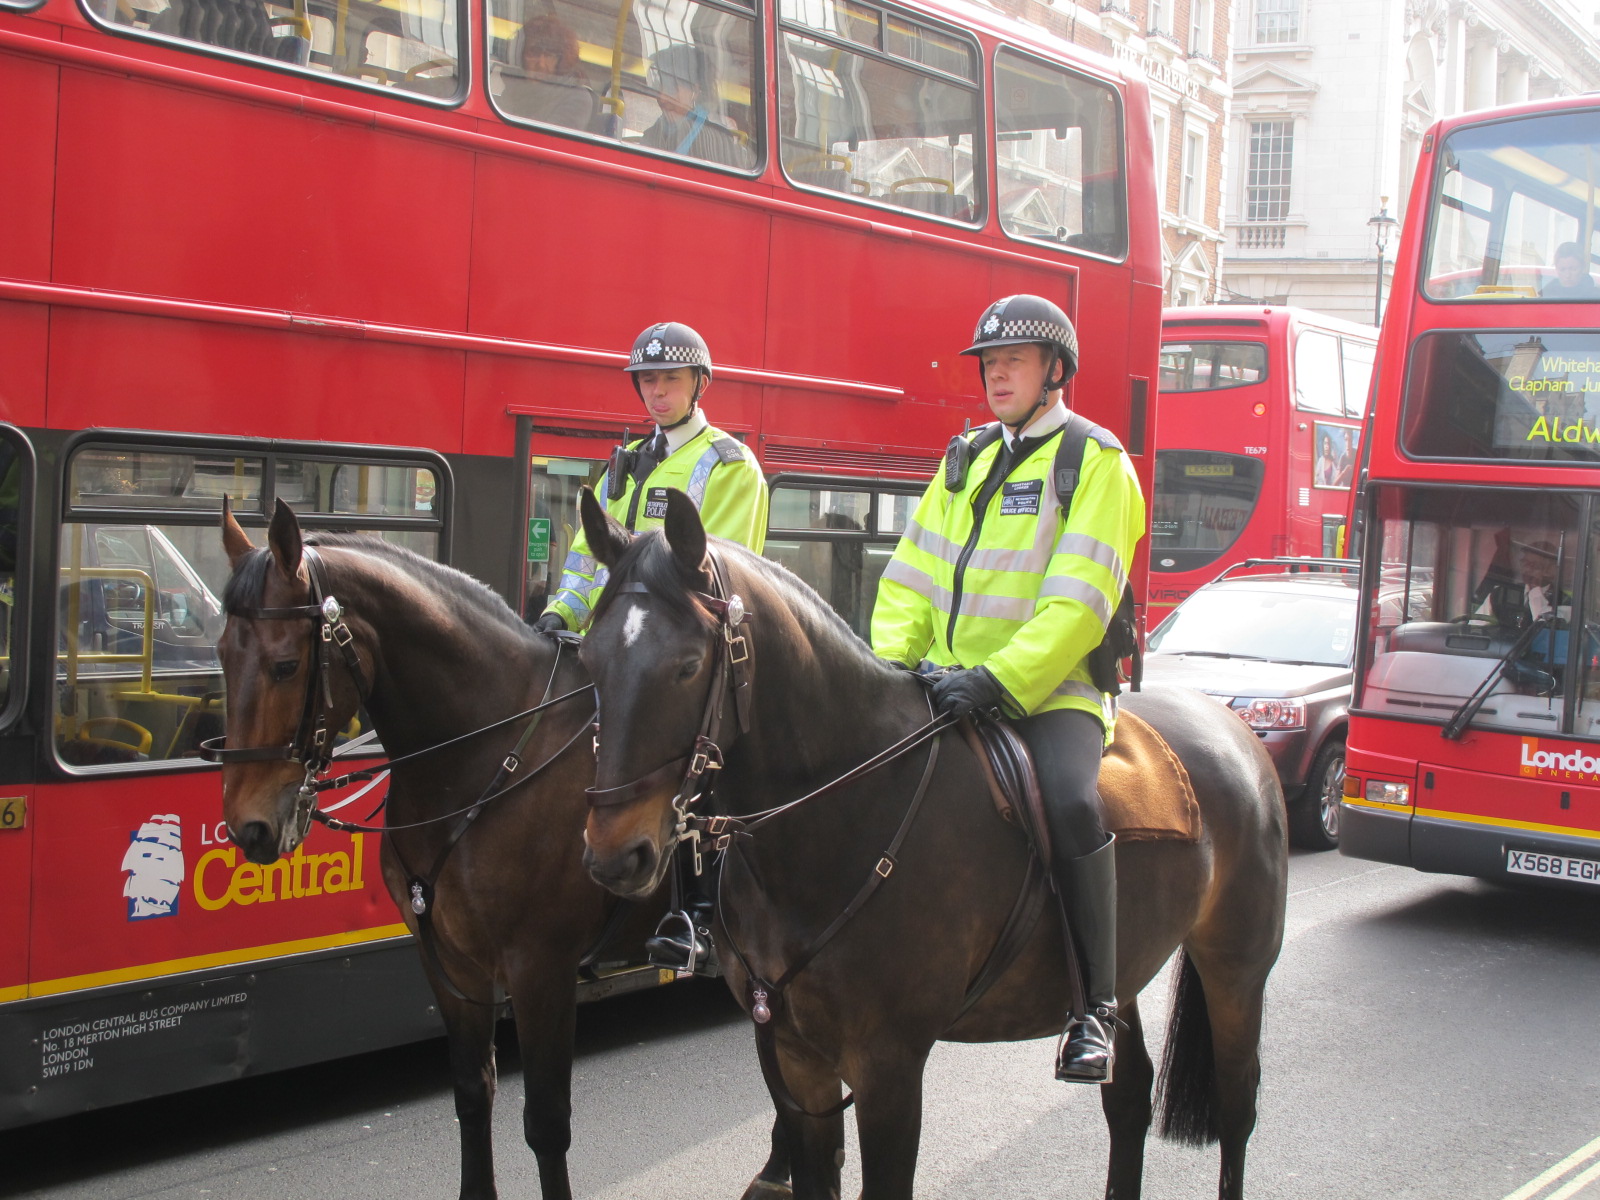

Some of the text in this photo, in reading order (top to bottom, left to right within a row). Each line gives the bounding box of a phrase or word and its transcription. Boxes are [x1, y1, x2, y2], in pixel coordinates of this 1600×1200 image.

[1140, 55, 1200, 100] CLARENCE
[1541, 356, 1600, 373] Whiteha
[1508, 375, 1600, 396] Clapham Ju
[1526, 415, 1600, 443] Aldw
[1244, 446, 1267, 454] TE679
[132, 622, 165, 630] TRSIT
[1523, 766, 1599, 781] GENERA
[2, 801, 16, 826] 6
[193, 833, 364, 911] Central
[1511, 851, 1562, 875] X568
[43, 992, 248, 1040] LONDON CENTRAL BUS COMPANY LIMITED
[43, 1015, 183, 1053] No. 18 MERTON HIGH STREET
[42, 1046, 89, 1066] LONDON
[42, 1058, 94, 1078] SW19 1DN
